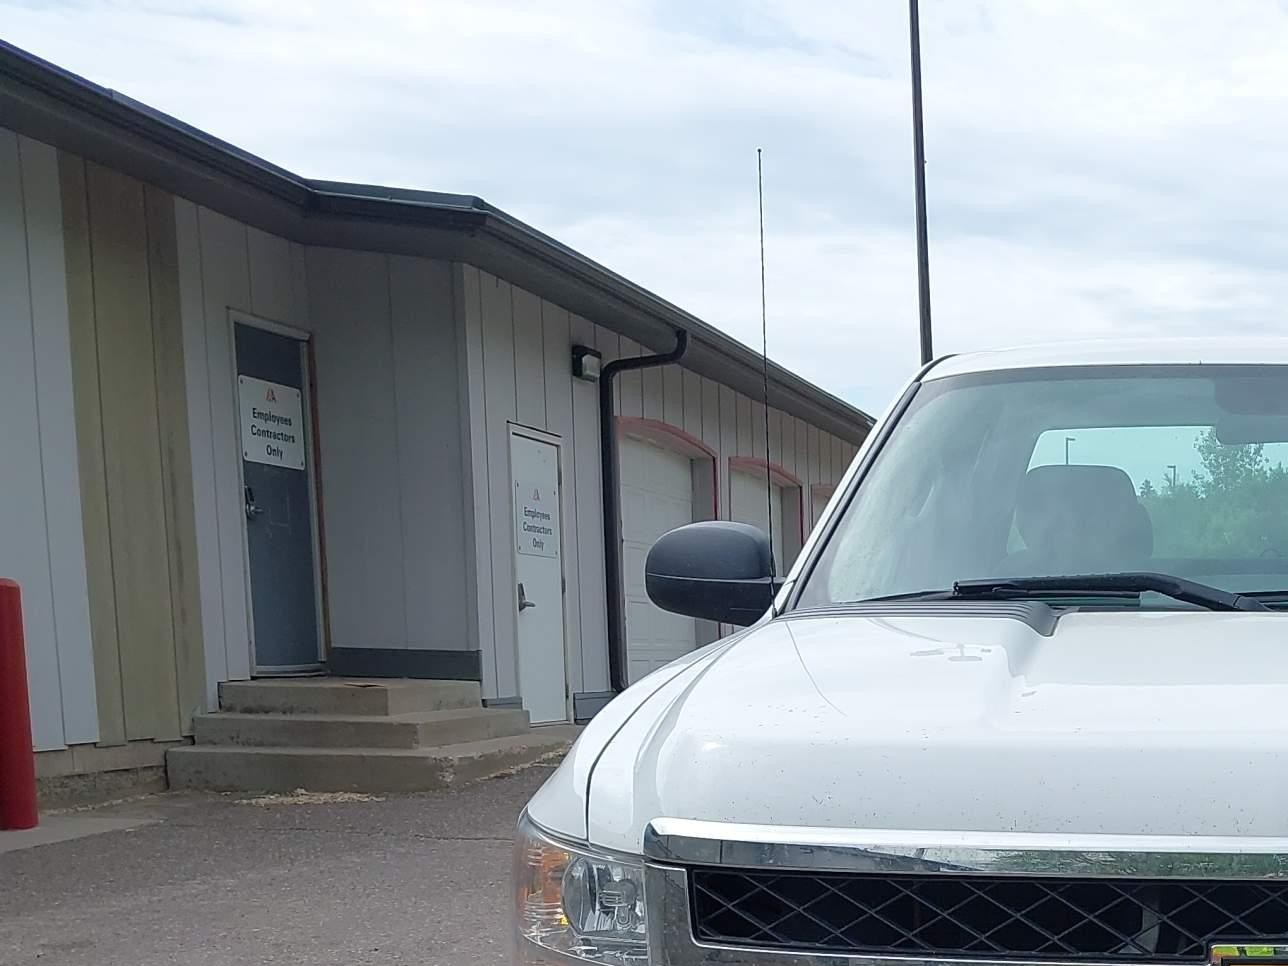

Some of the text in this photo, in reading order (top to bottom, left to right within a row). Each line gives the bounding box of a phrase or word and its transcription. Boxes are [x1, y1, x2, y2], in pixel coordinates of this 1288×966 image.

[252, 407, 292, 426] Employees
[251, 424, 295, 443] Contractors
[266, 444, 283, 461] Only
[523, 506, 551, 521] Employees
[523, 521, 552, 536] Contractors
[532, 537, 544, 552] Only
